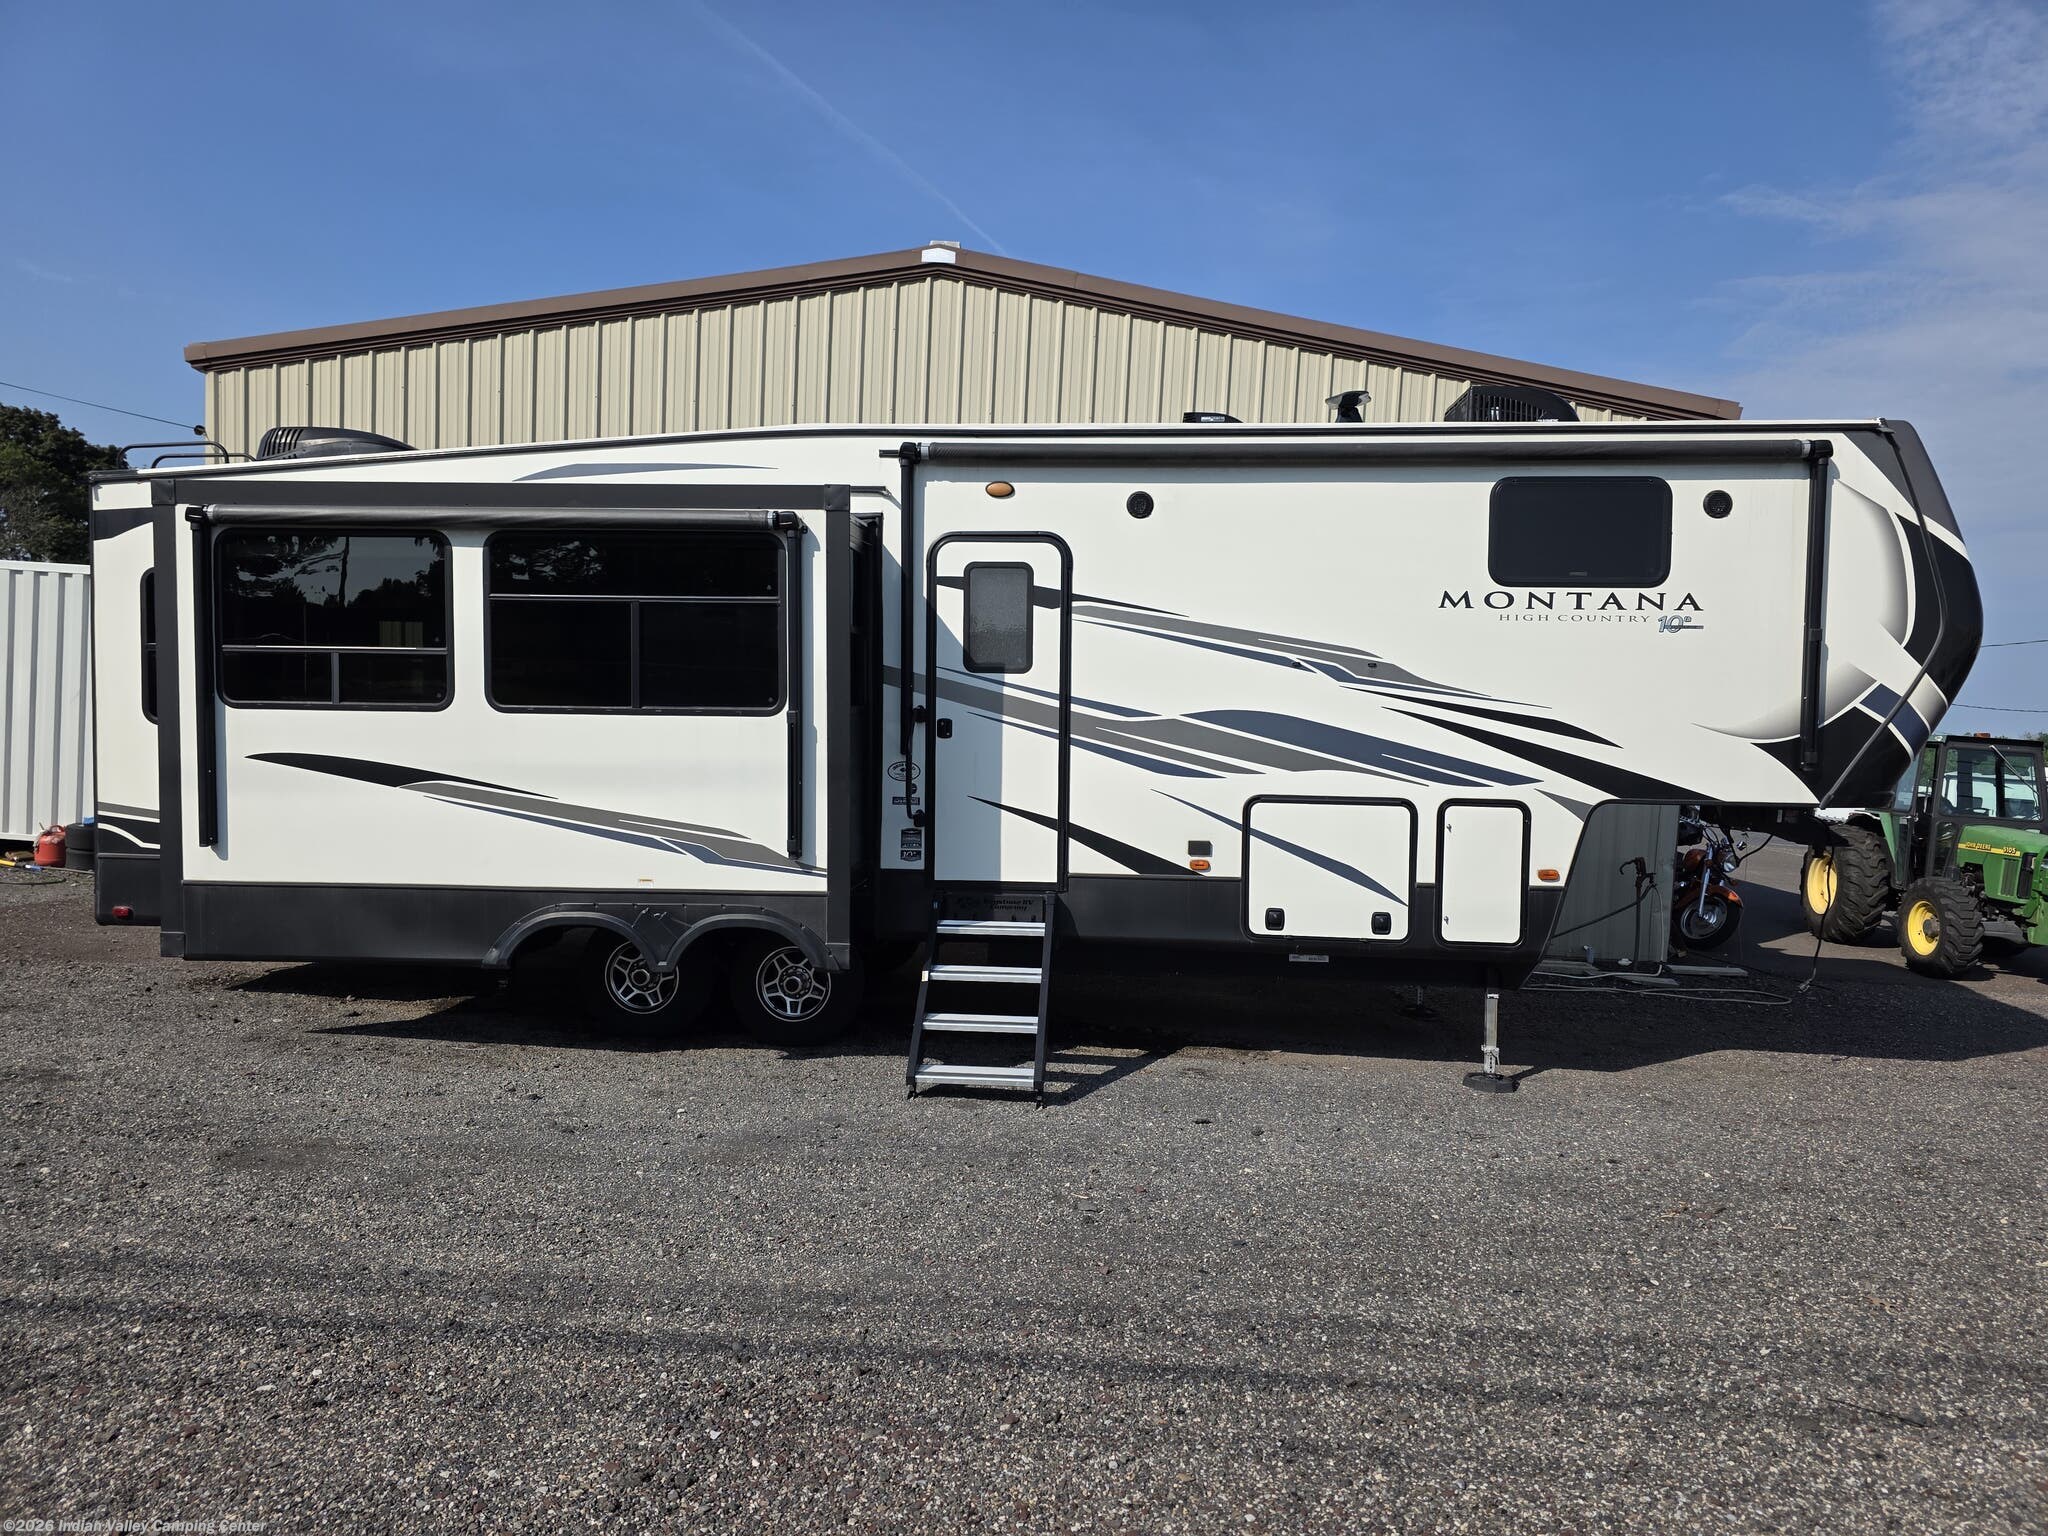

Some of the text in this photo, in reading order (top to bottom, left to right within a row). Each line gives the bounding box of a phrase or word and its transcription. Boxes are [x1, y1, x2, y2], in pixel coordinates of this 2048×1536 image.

[1438, 590, 1704, 611] MONTANA
[1499, 613, 1651, 623] HIGH COUNTRY
